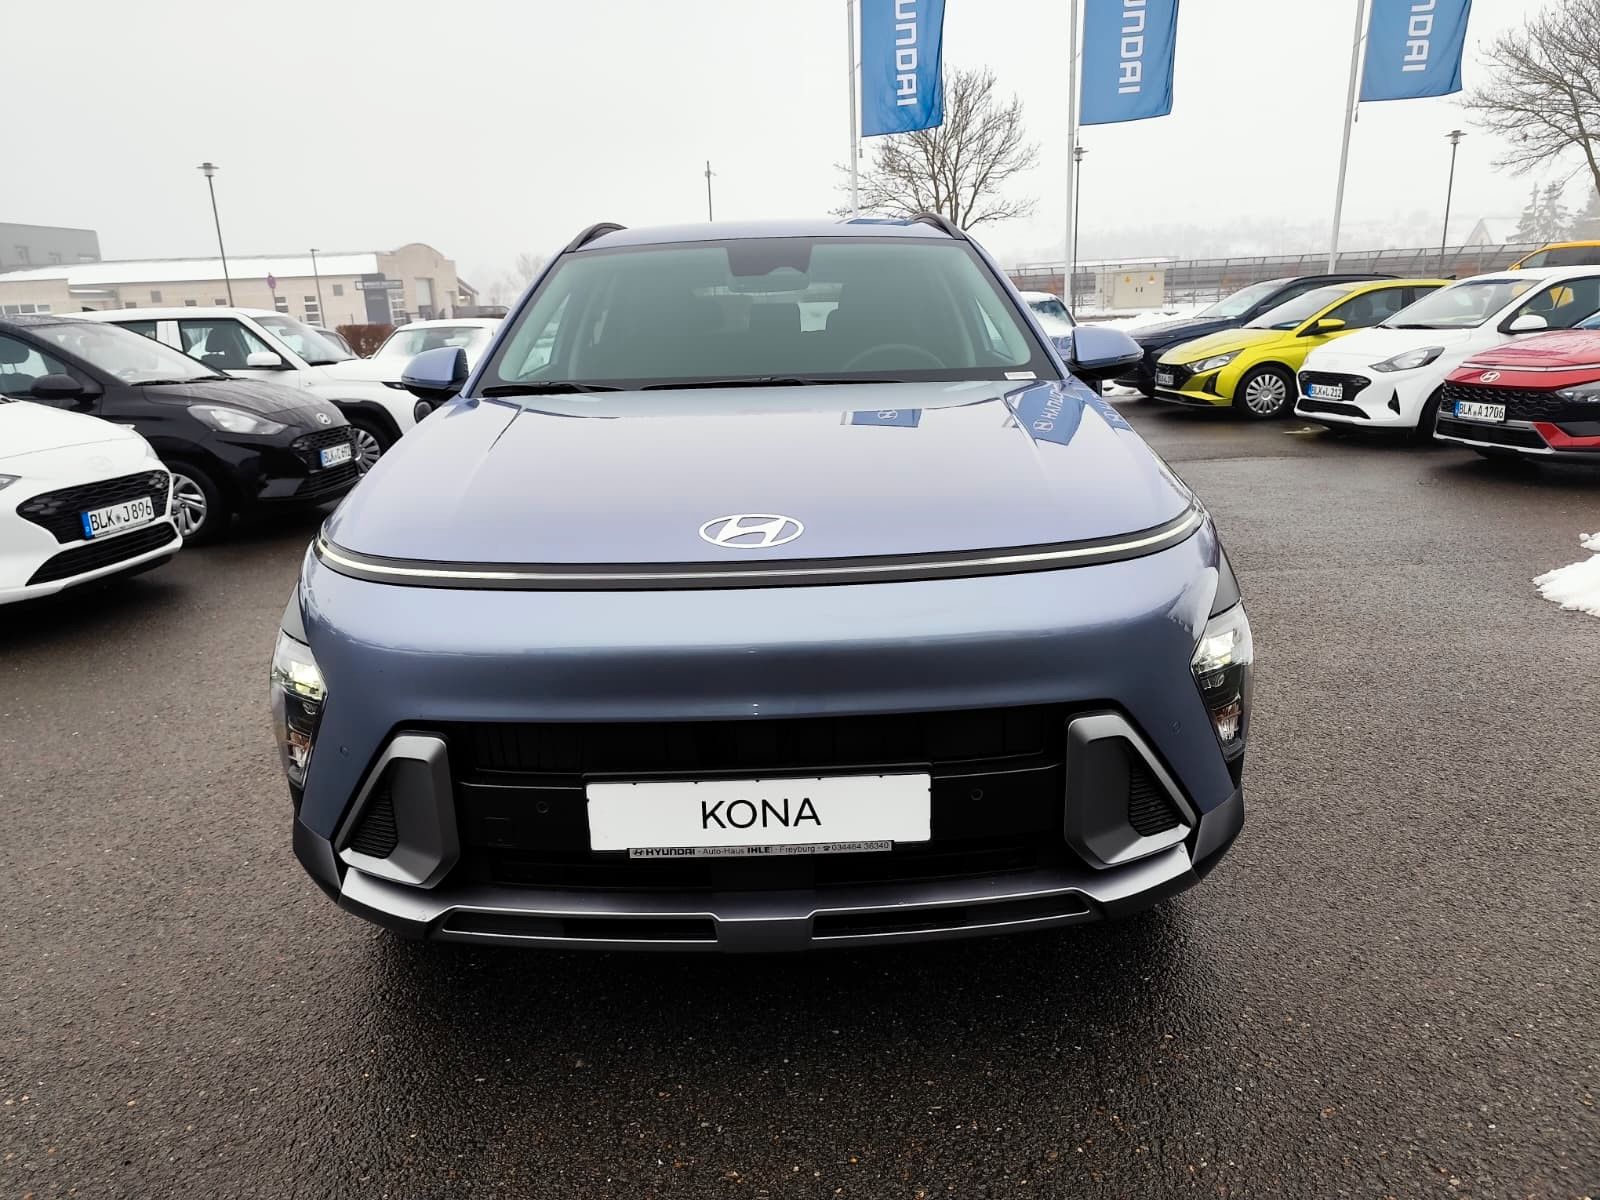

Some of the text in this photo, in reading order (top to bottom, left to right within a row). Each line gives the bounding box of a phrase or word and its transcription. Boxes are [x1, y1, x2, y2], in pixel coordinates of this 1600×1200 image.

[1459, 402, 1473, 416] BLK
[1484, 406, 1504, 419] 1706
[90, 499, 152, 531] BLK J 896
[701, 798, 822, 829] KONA
[645, 847, 696, 856] HYUNDAI
[703, 846, 745, 855] Auto-Haus
